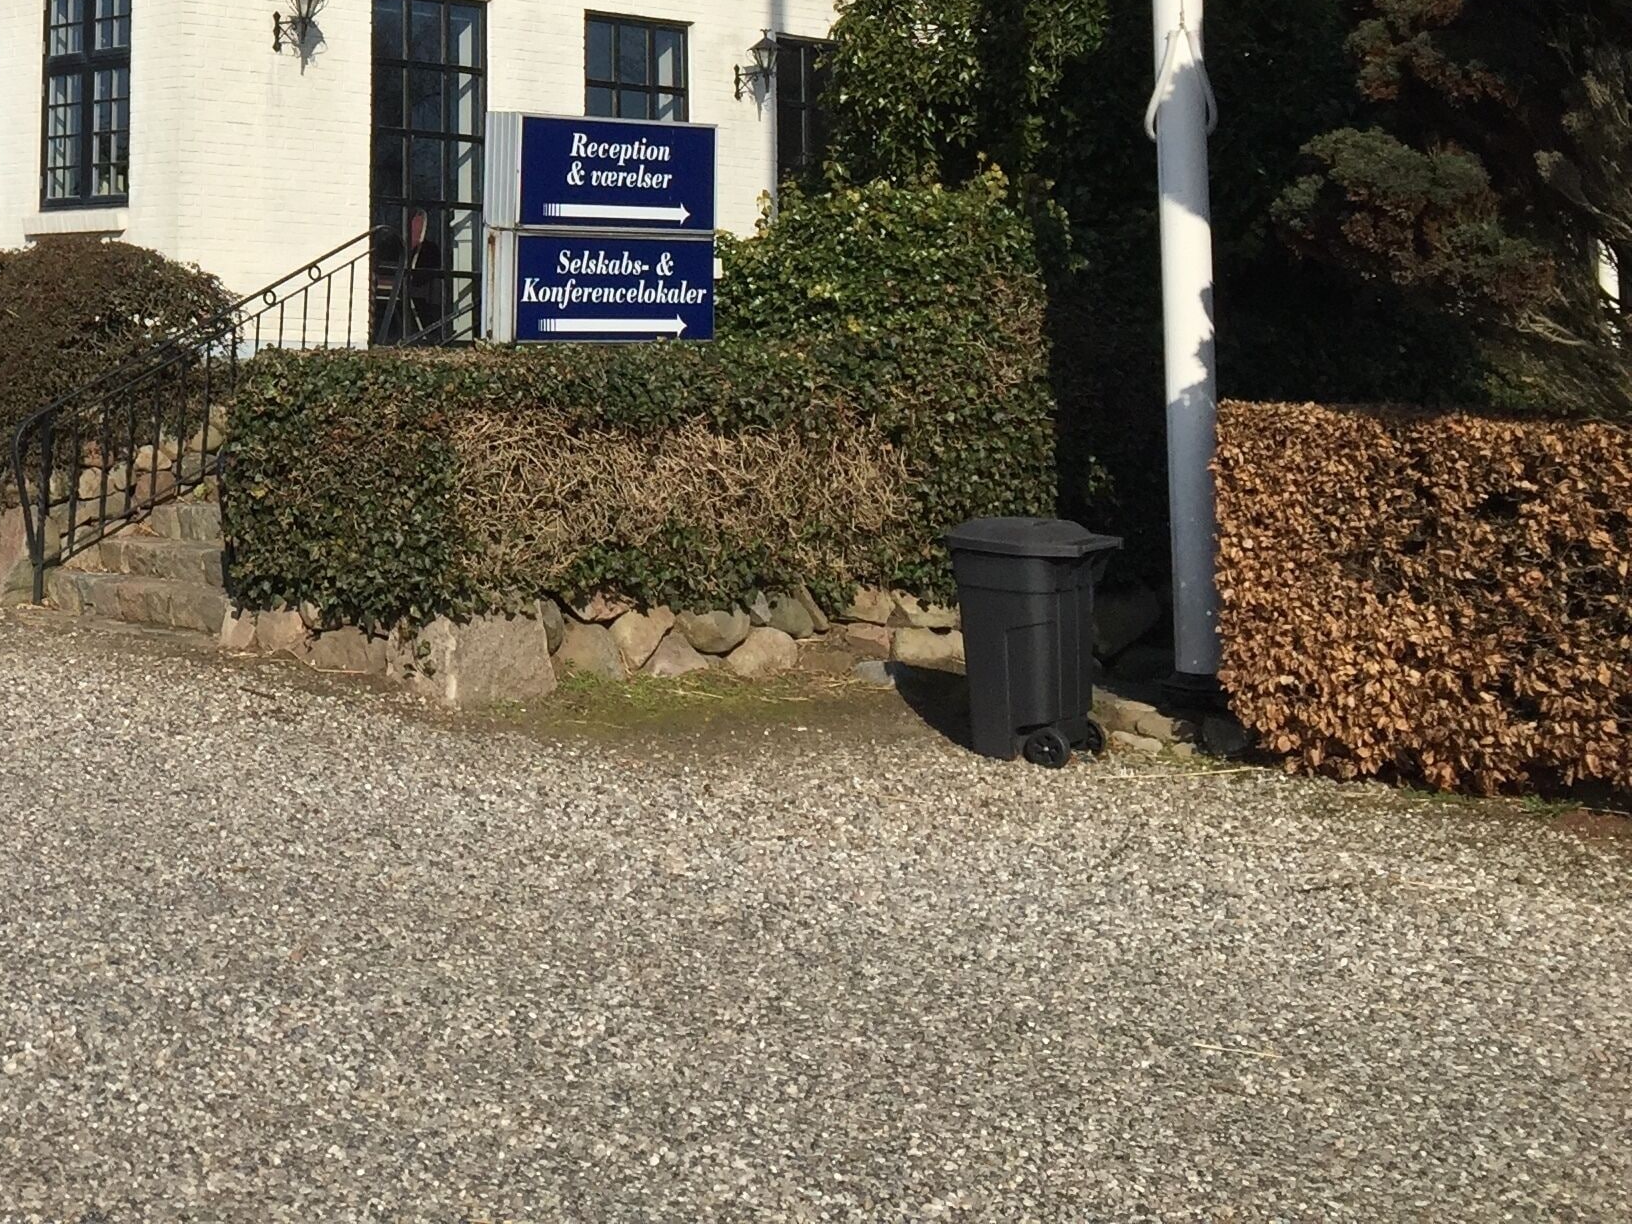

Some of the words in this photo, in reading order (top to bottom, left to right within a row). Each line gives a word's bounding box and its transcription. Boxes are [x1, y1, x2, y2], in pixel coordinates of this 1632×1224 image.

[569, 132, 671, 166] Reception
[566, 161, 586, 186] &
[591, 164, 673, 189] værelser
[556, 249, 650, 276] Selskabs-
[655, 251, 674, 277] &
[520, 277, 707, 309] Konferencelokaler
